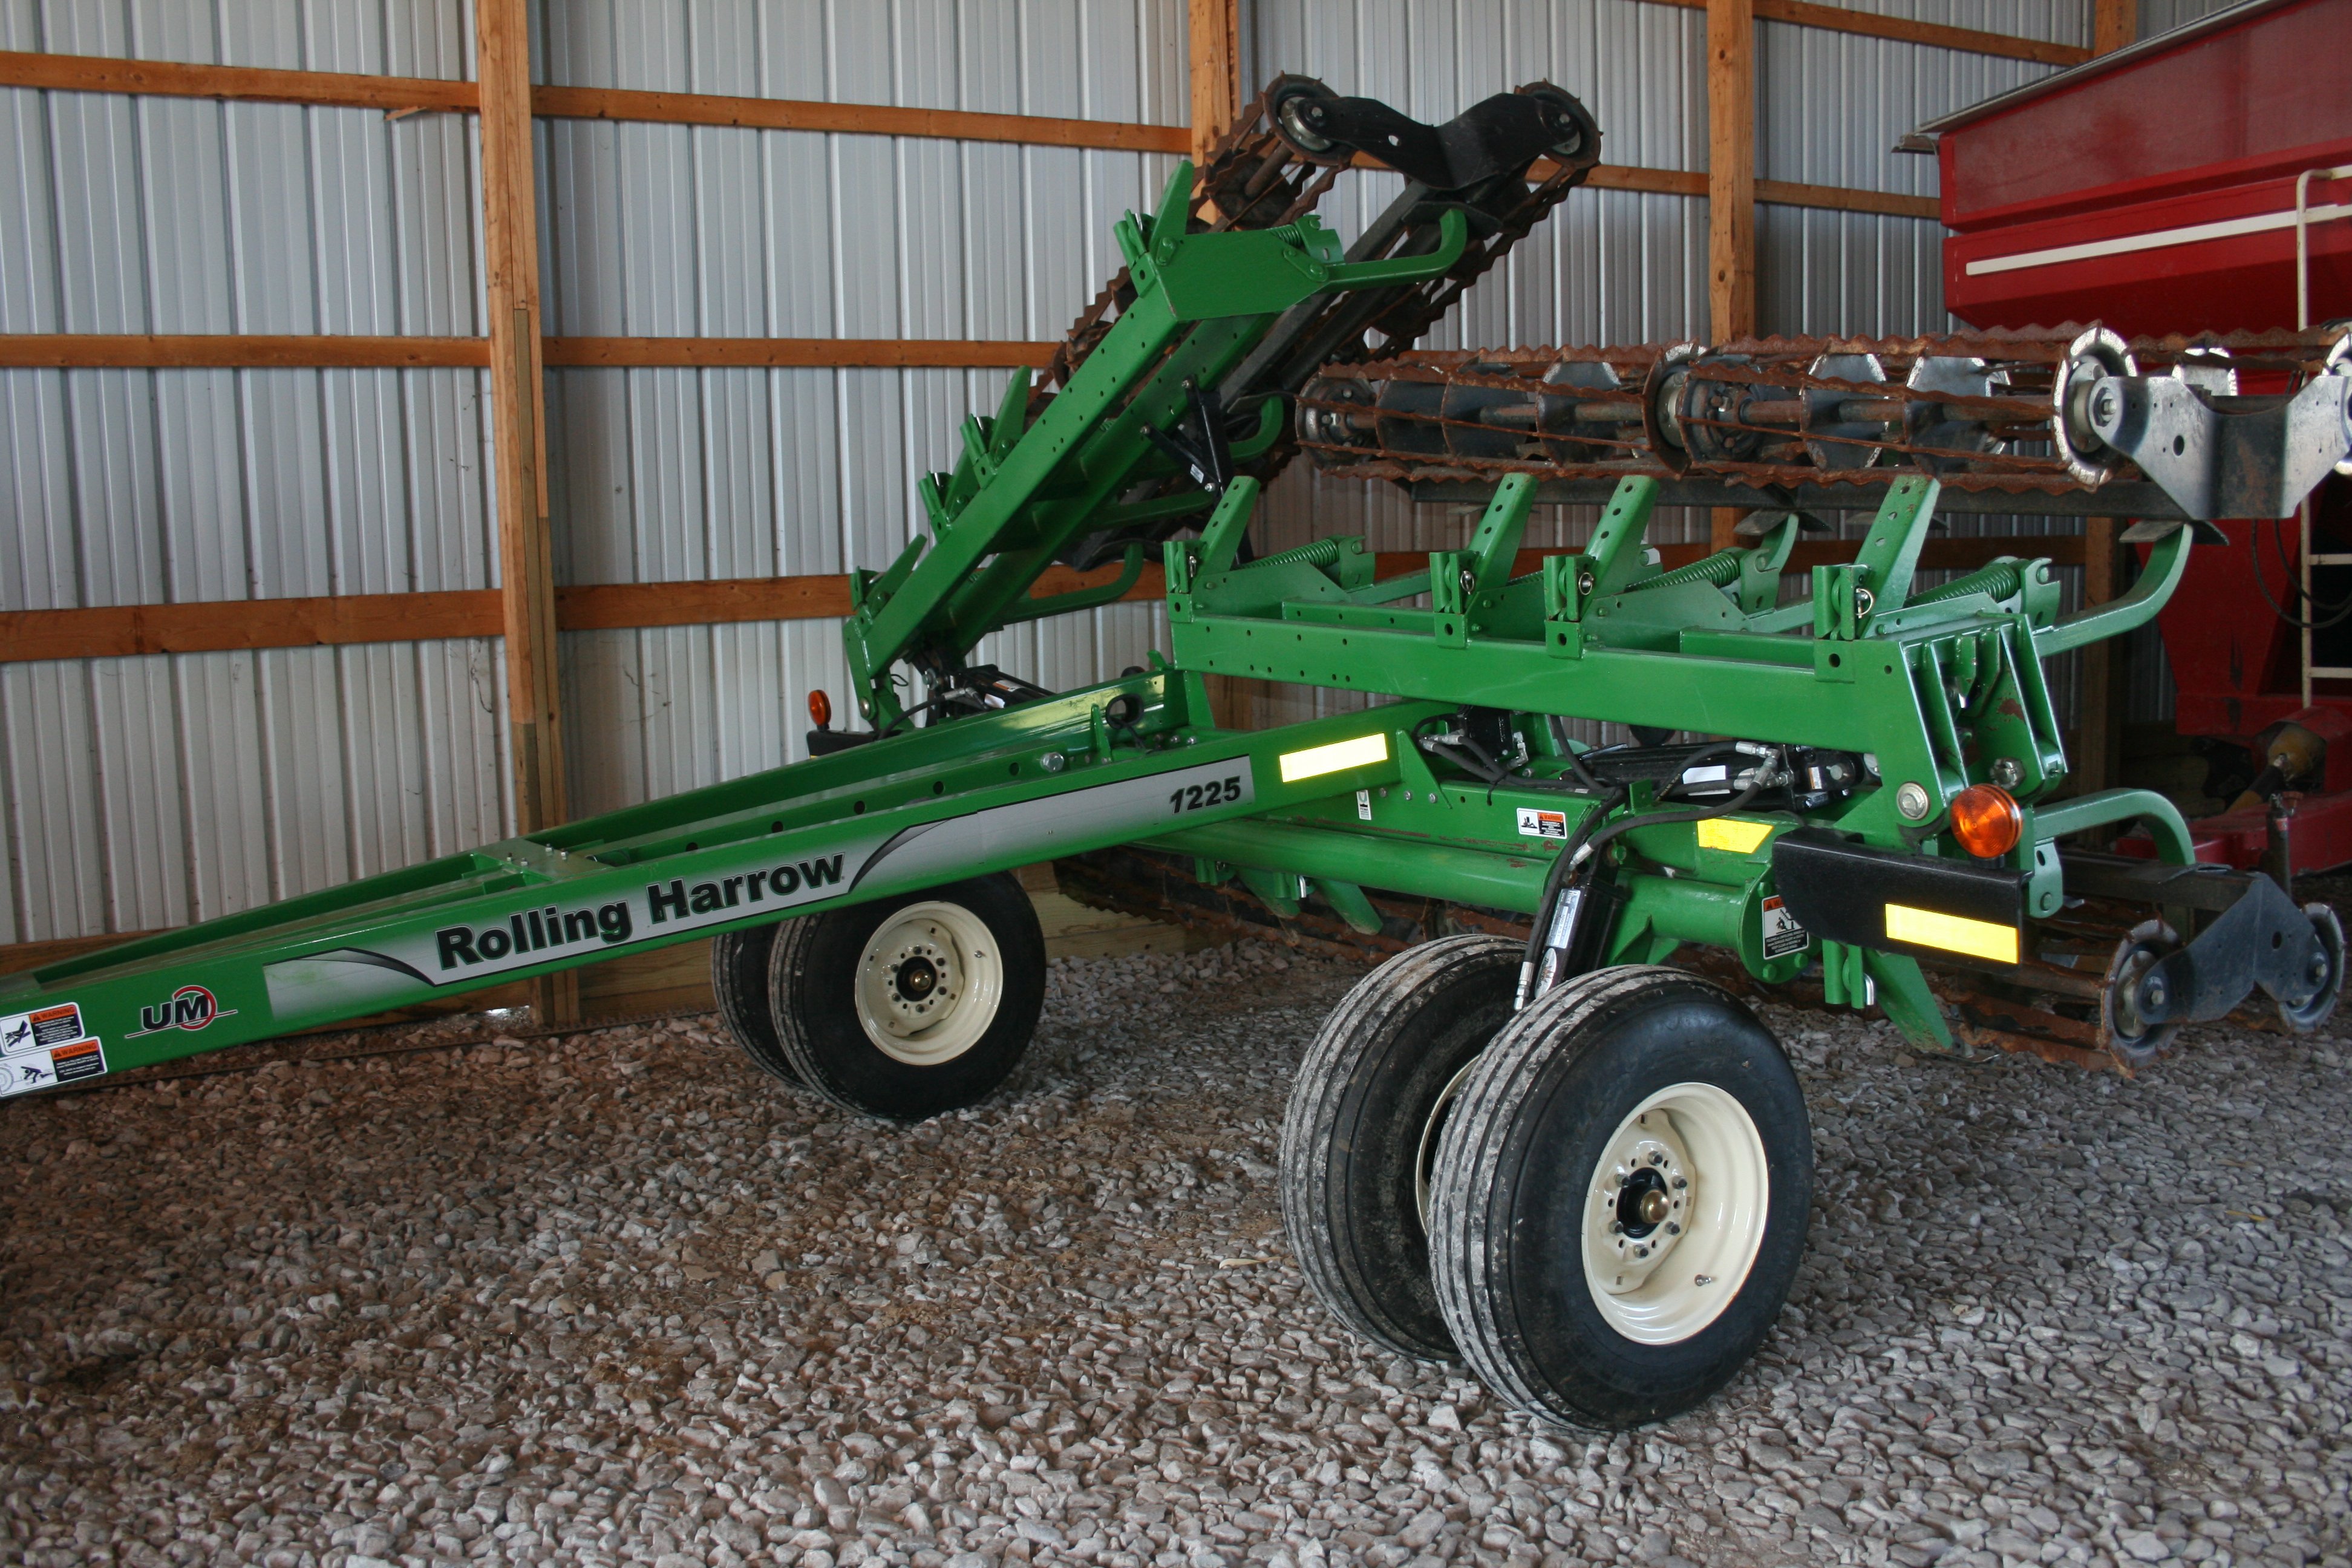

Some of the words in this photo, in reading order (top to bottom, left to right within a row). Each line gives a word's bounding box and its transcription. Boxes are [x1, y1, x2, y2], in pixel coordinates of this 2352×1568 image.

[1169, 776, 1241, 815] 1225
[434, 900, 633, 970] Rolling
[646, 852, 845, 924] Harrow
[142, 994, 210, 1030] UM
[61, 1043, 96, 1054] WARNING
